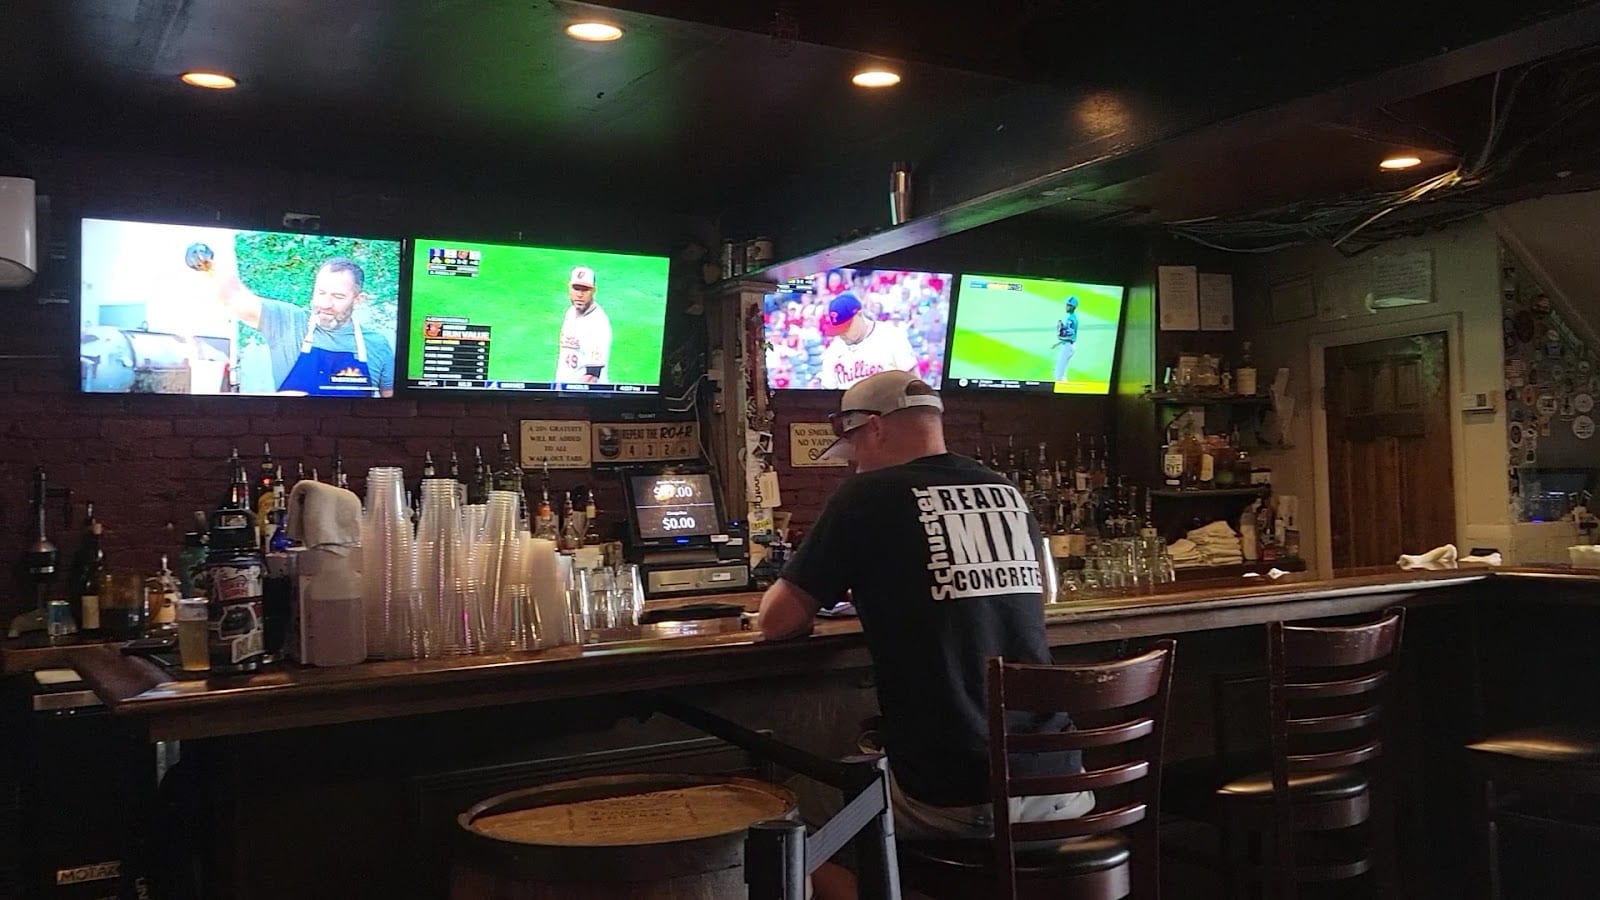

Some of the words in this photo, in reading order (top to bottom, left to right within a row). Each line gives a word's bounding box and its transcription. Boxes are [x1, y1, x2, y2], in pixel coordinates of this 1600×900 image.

[646, 428, 658, 439] THE
[660, 425, 693, 439] ROAR
[1166, 463, 1181, 473] RYE
[937, 486, 1020, 511] READY
[662, 516, 696, 531] $0.00
[911, 487, 953, 601] Schuster
[943, 511, 1037, 565] MIX
[954, 567, 1042, 592] CONCRETE
